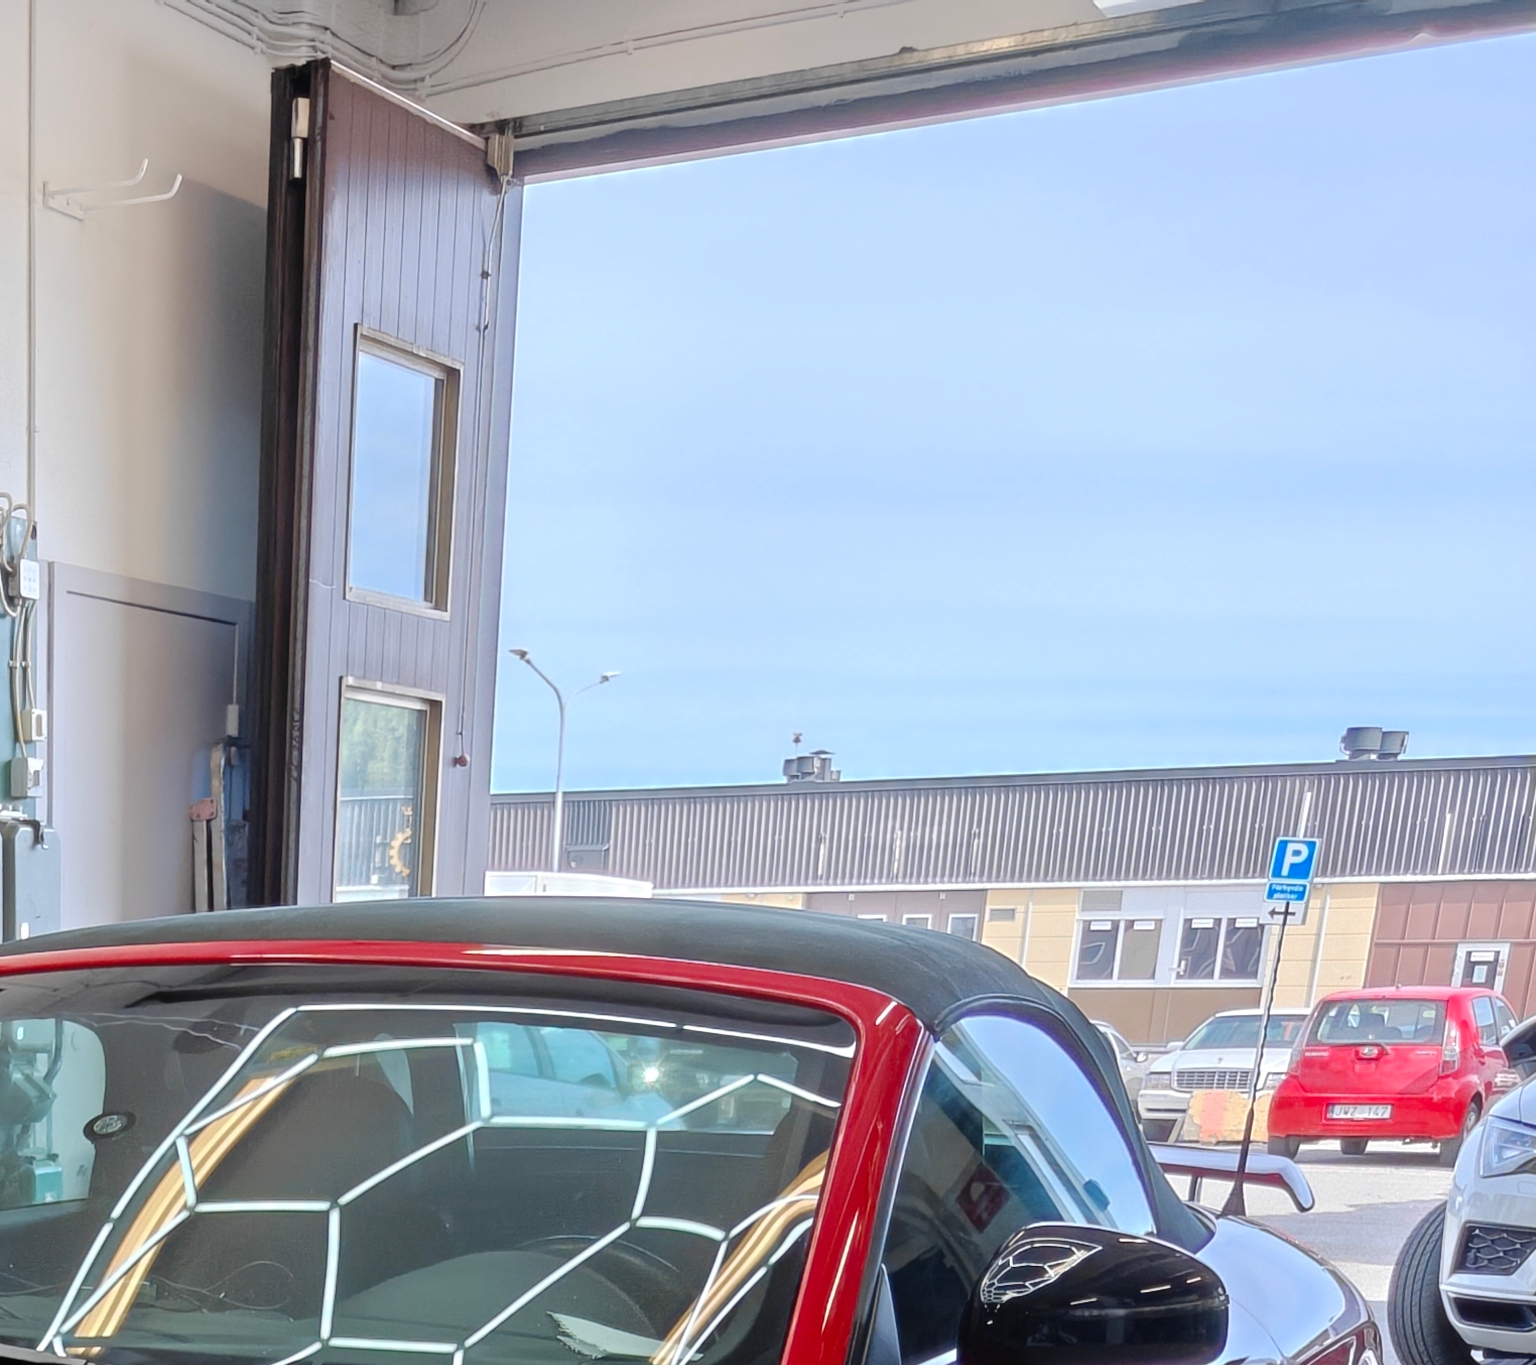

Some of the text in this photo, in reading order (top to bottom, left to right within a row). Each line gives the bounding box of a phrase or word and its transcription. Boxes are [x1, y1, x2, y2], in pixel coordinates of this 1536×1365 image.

[1280, 842, 1309, 877] P
[1335, 1106, 1389, 1117] JWZ 147
